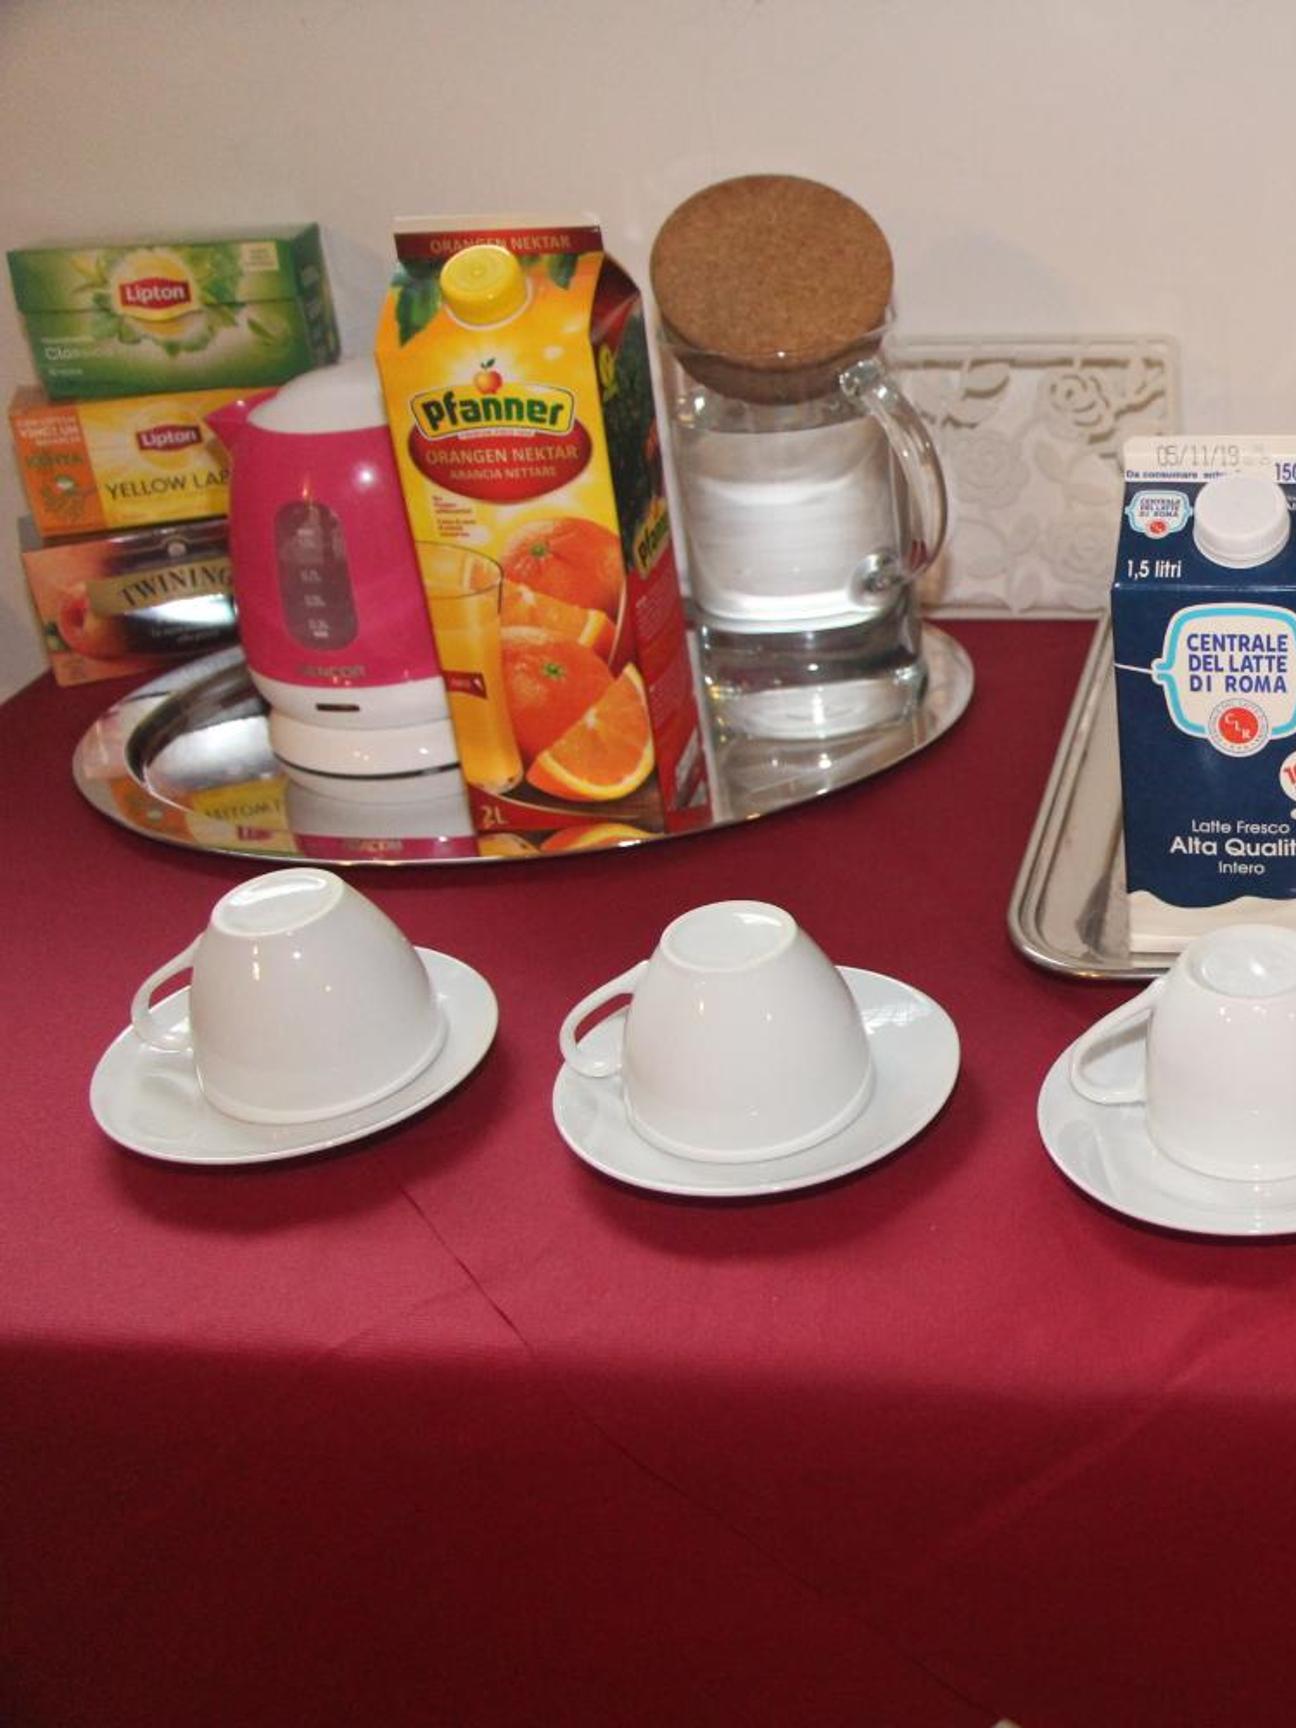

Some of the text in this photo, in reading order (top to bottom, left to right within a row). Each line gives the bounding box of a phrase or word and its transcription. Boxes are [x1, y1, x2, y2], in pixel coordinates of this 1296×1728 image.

[511, 235, 572, 250] NEKTAR
[125, 285, 186, 304] Lipton
[421, 391, 565, 431] pfanner
[140, 429, 197, 448] Lipton
[425, 445, 579, 465] ORANGEN NEKTAR
[1156, 444, 1240, 467] 05/11/19
[105, 475, 187, 500] YELLOW
[1127, 559, 1182, 579] 1,5 litri
[1187, 634, 1288, 652] CENTRALE
[1189, 654, 1288, 673] DEL LATTE
[1190, 675, 1287, 693] DI ROMA
[1191, 819, 1290, 834] Latte Fresco
[1170, 837, 1217, 855] Alta
[1218, 861, 1266, 876] Intero
